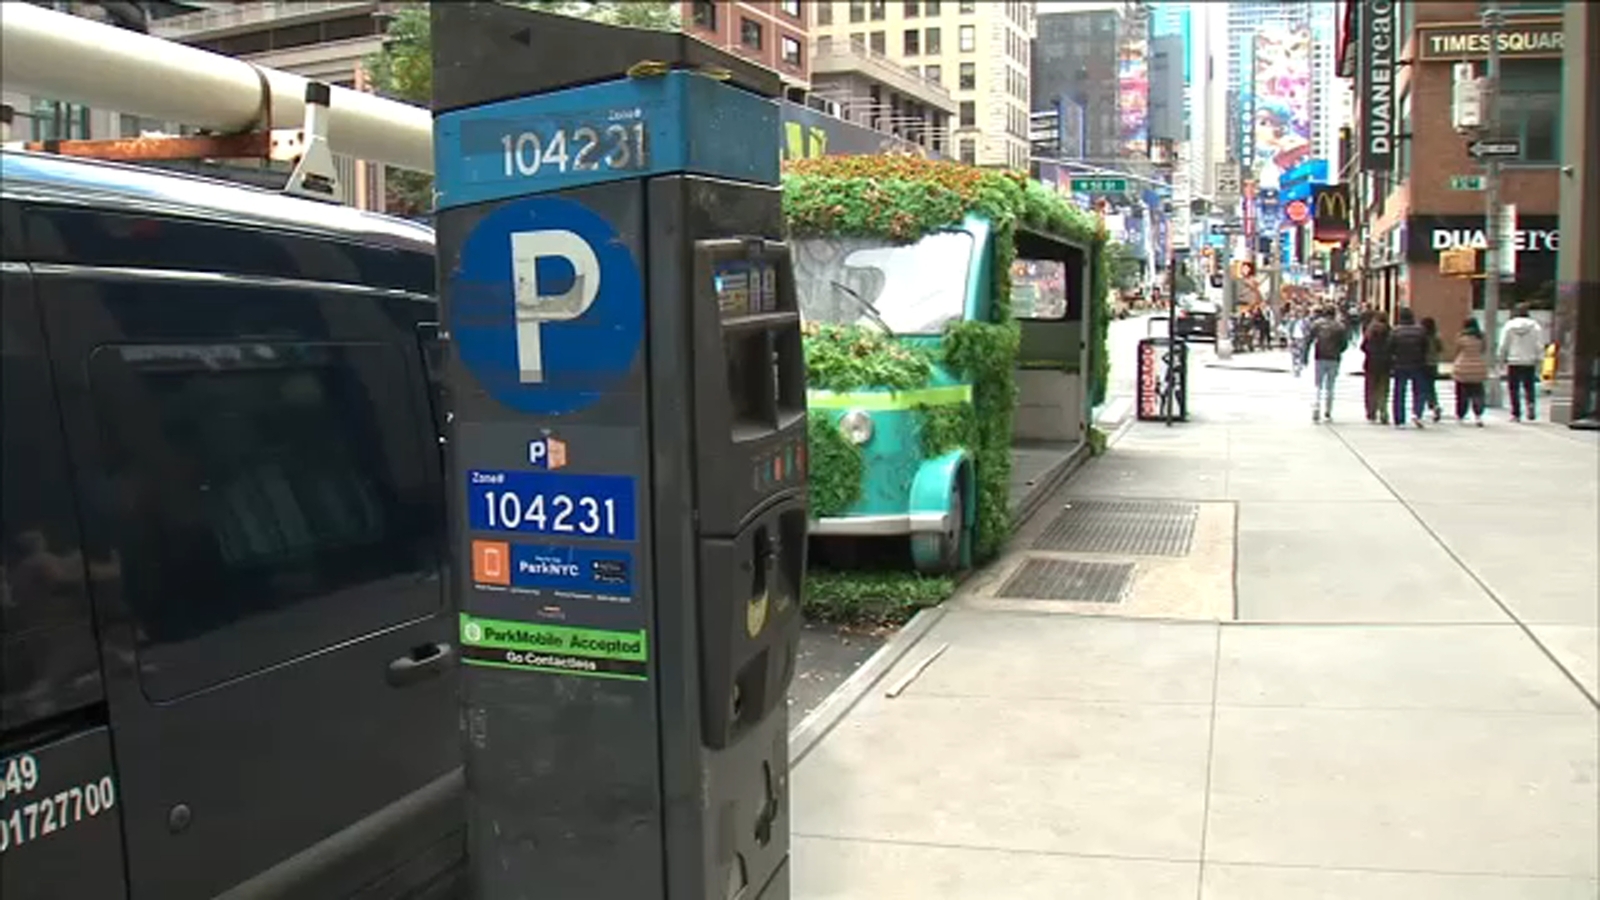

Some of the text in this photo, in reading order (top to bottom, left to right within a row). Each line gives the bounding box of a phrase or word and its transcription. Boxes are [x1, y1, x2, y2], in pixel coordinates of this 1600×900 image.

[1430, 34, 1491, 52] TIMES
[501, 121, 645, 177] 104231
[511, 229, 600, 384] P
[484, 491, 615, 535] 104231
[518, 560, 581, 577] ParkNYC
[484, 627, 641, 654] ParkMobile Accepted
[505, 651, 597, 671] Go Contactless
